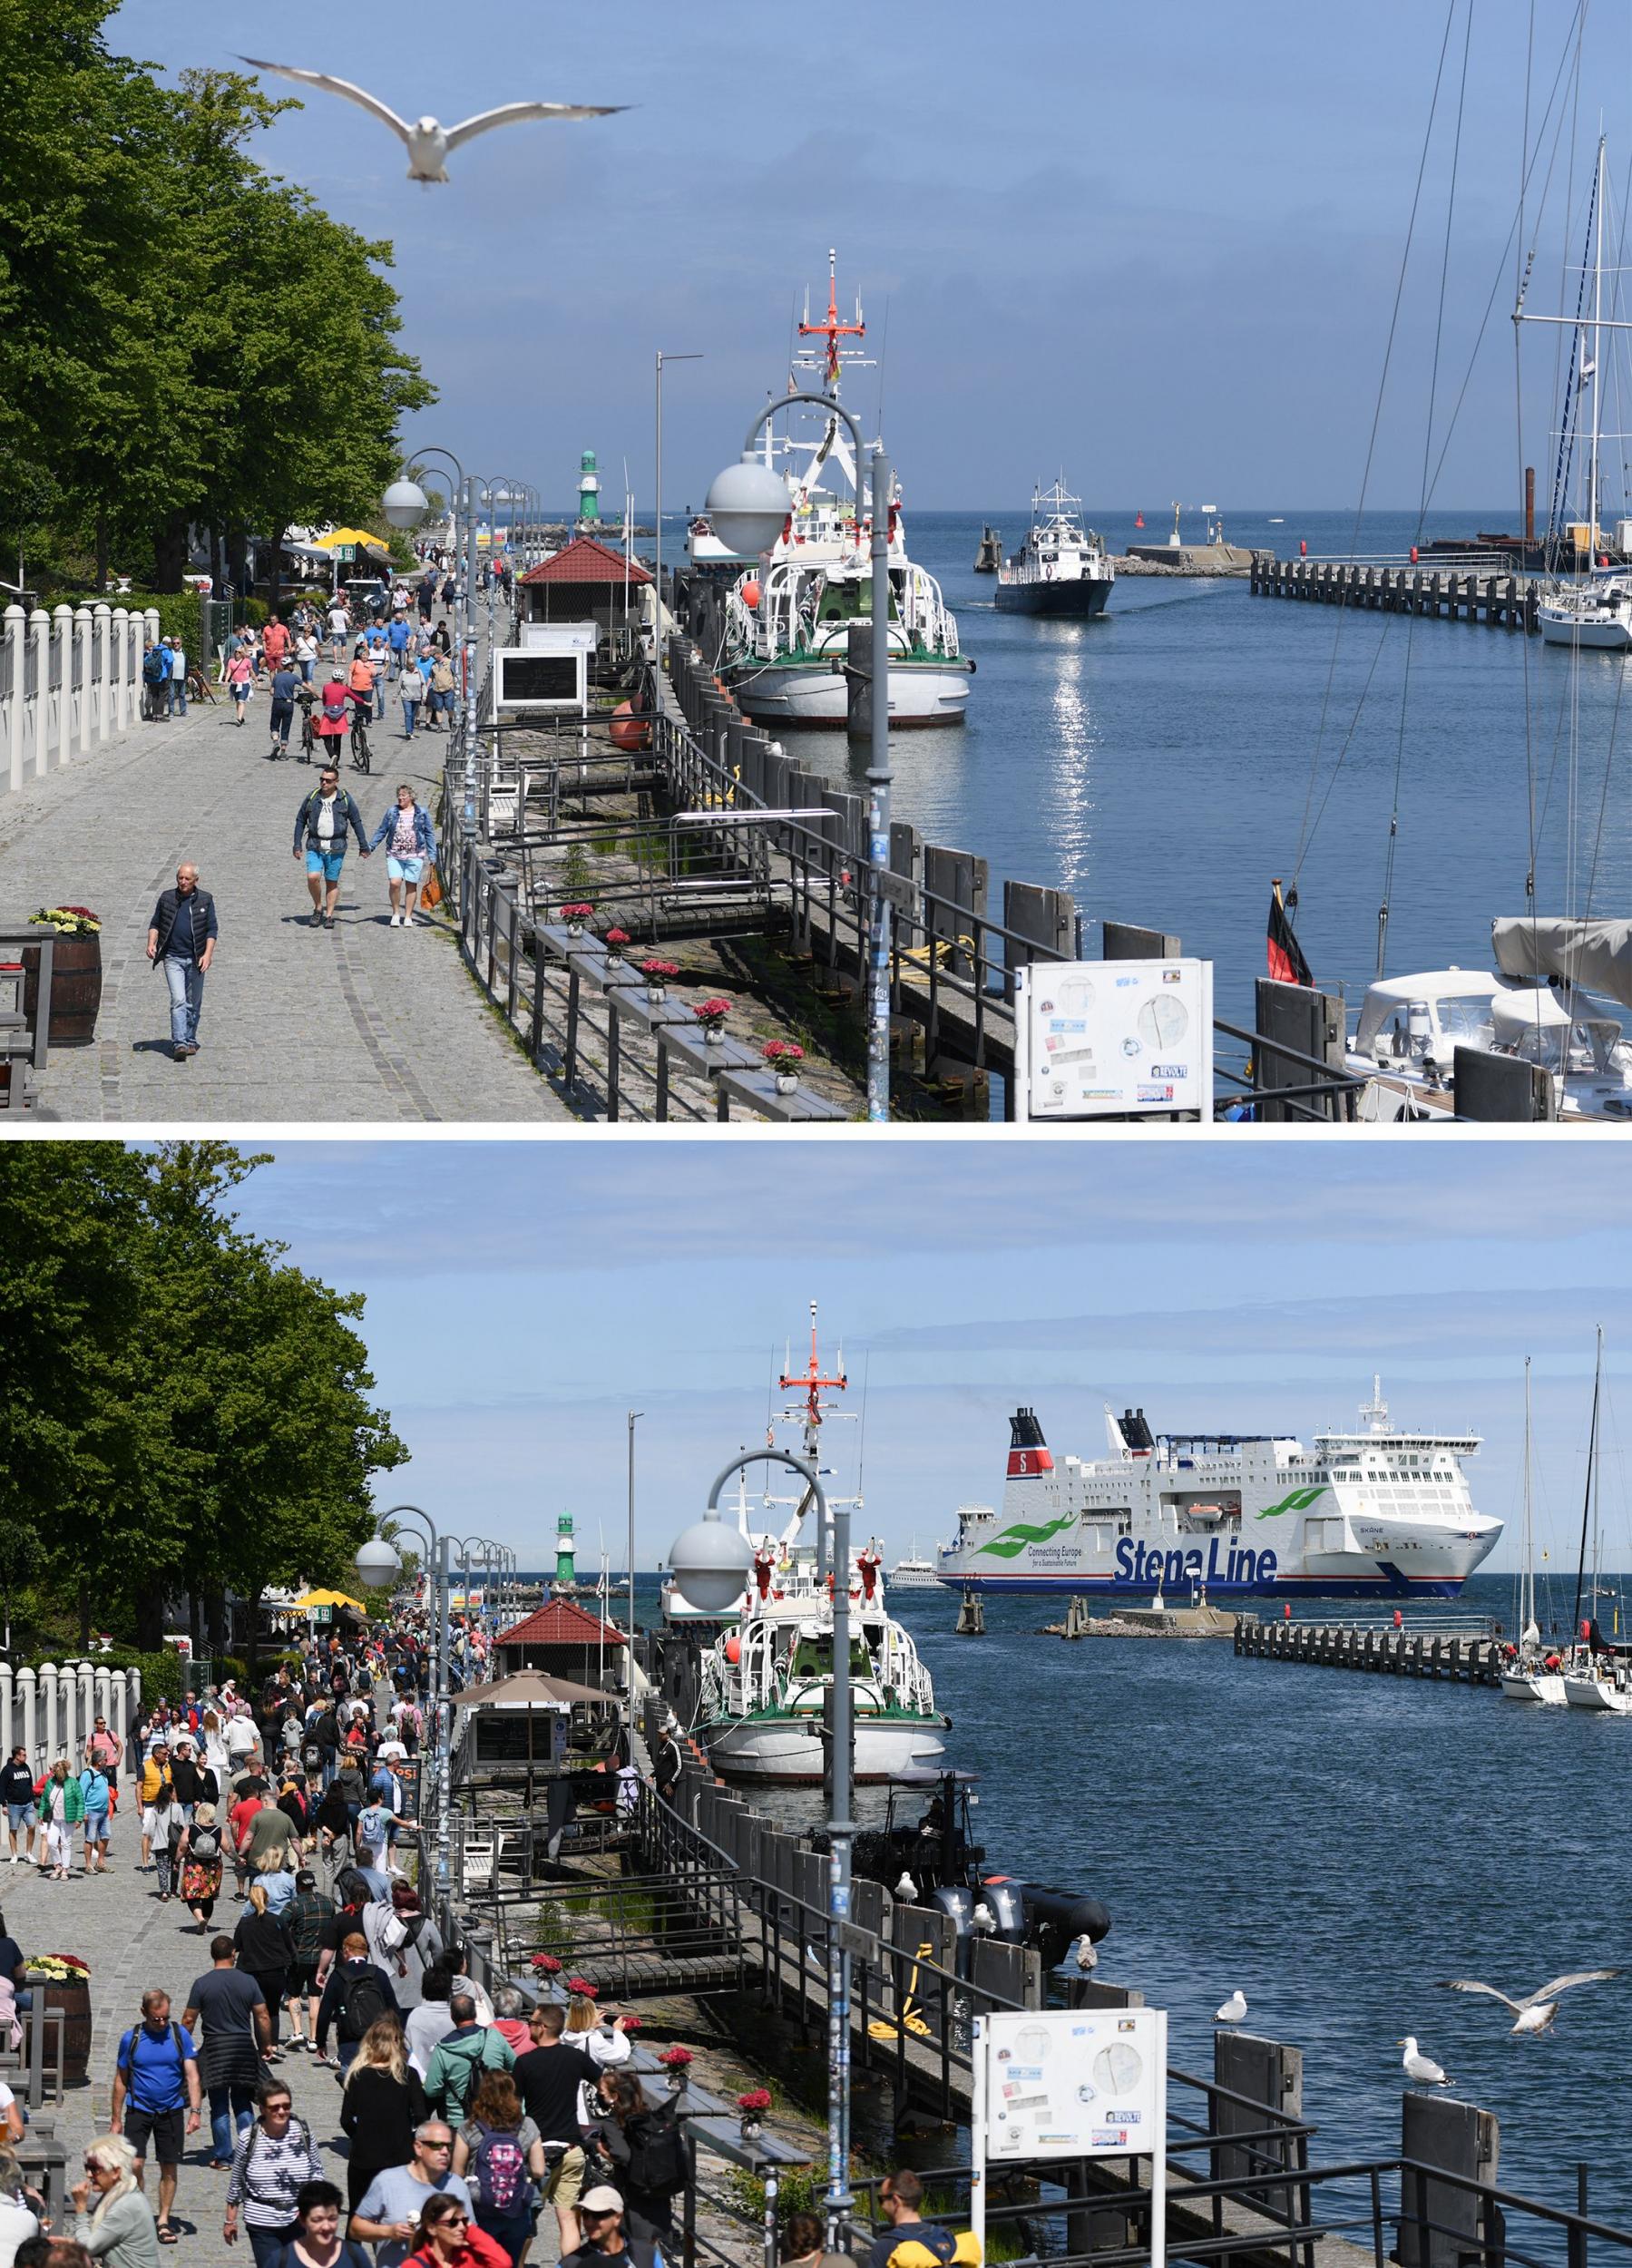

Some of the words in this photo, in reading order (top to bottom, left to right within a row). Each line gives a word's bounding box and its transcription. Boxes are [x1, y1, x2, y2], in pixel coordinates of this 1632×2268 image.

[1160, 1066, 1187, 1077] REVOLTE
[1020, 1452, 1027, 1473] S
[1028, 1546, 1060, 1559] Connecting
[1062, 1546, 1082, 1559] Europe
